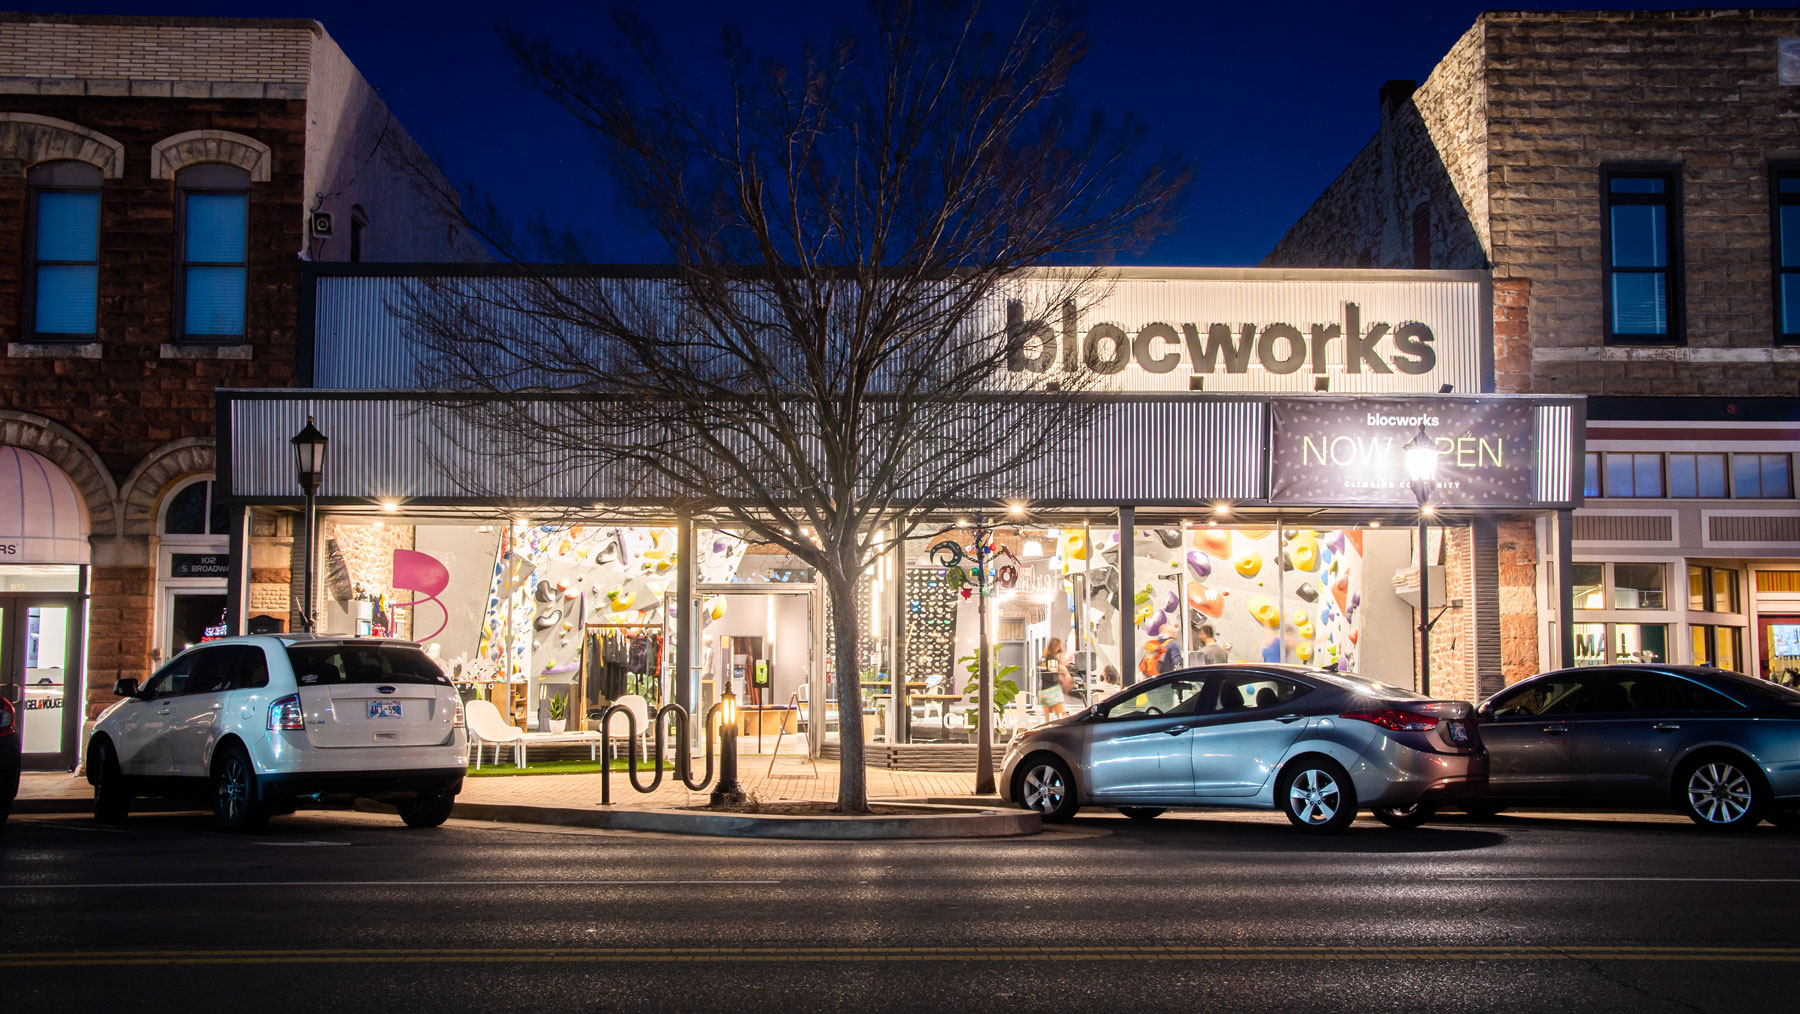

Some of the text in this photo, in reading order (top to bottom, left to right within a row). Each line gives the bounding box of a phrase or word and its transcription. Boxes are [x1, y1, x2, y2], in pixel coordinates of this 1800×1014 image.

[1006, 299, 1437, 375] blocworks
[1367, 413, 1440, 426] blocworks
[1303, 435, 1503, 468] NOW PEN
[1399, 481, 1461, 489] CONITY
[201, 556, 217, 564] 102
